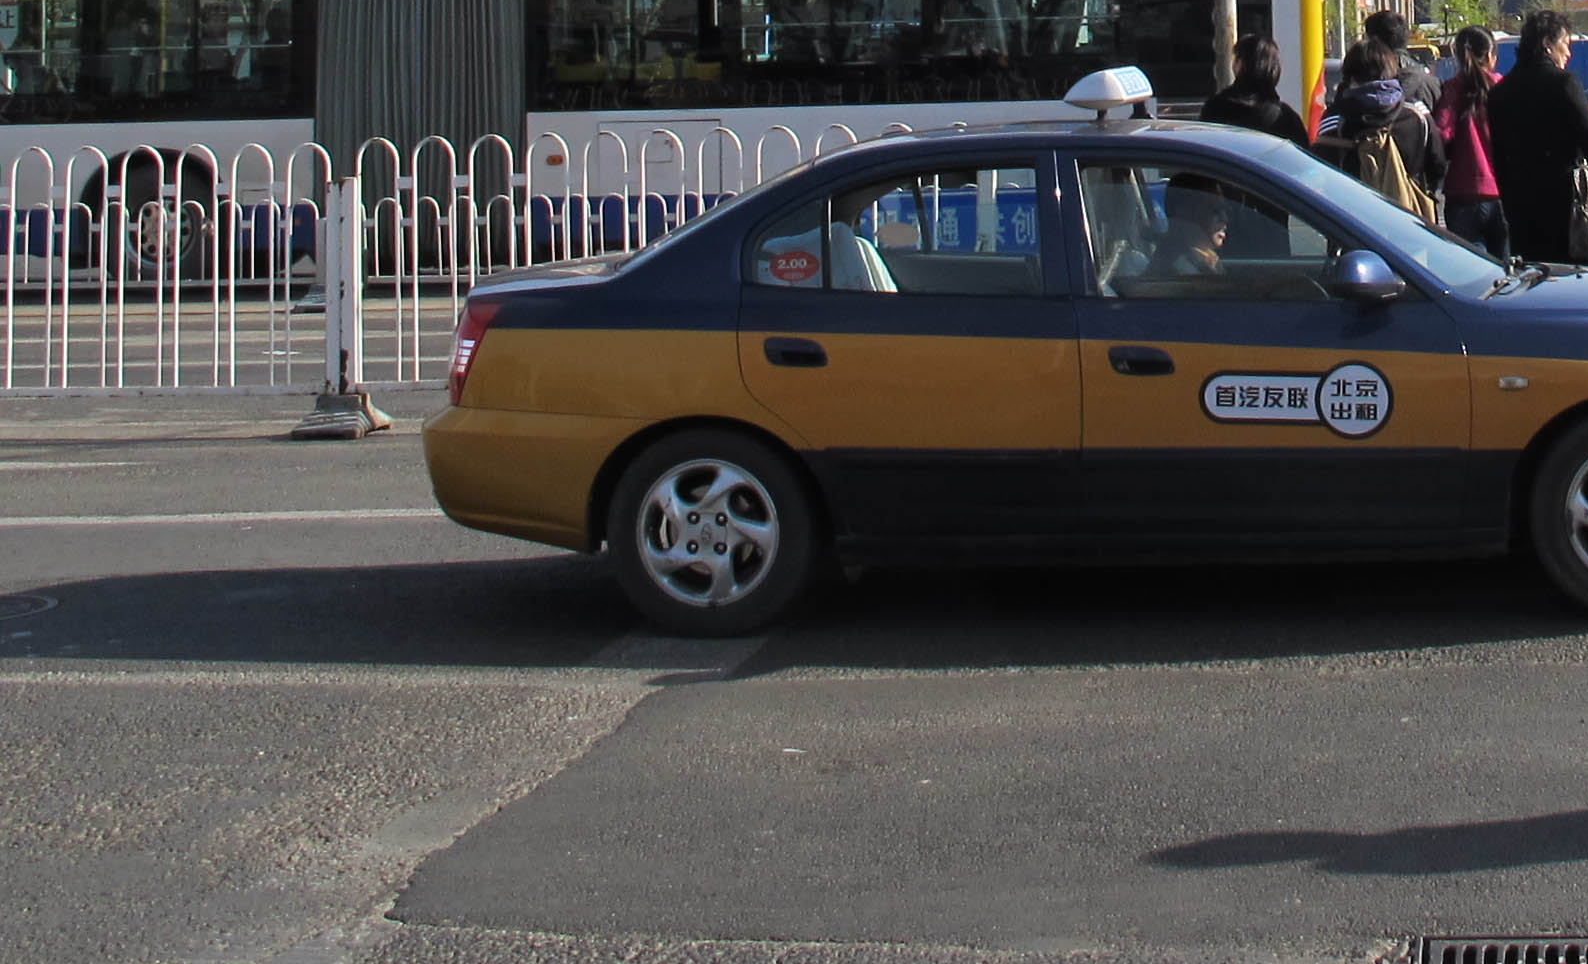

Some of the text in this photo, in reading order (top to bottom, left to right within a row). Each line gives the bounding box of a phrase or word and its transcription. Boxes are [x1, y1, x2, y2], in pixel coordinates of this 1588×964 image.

[777, 257, 808, 270] 2.00
[1215, 386, 1309, 409] 首汽友联
[1330, 379, 1379, 398] 北京
[1330, 402, 1378, 421] 出租
